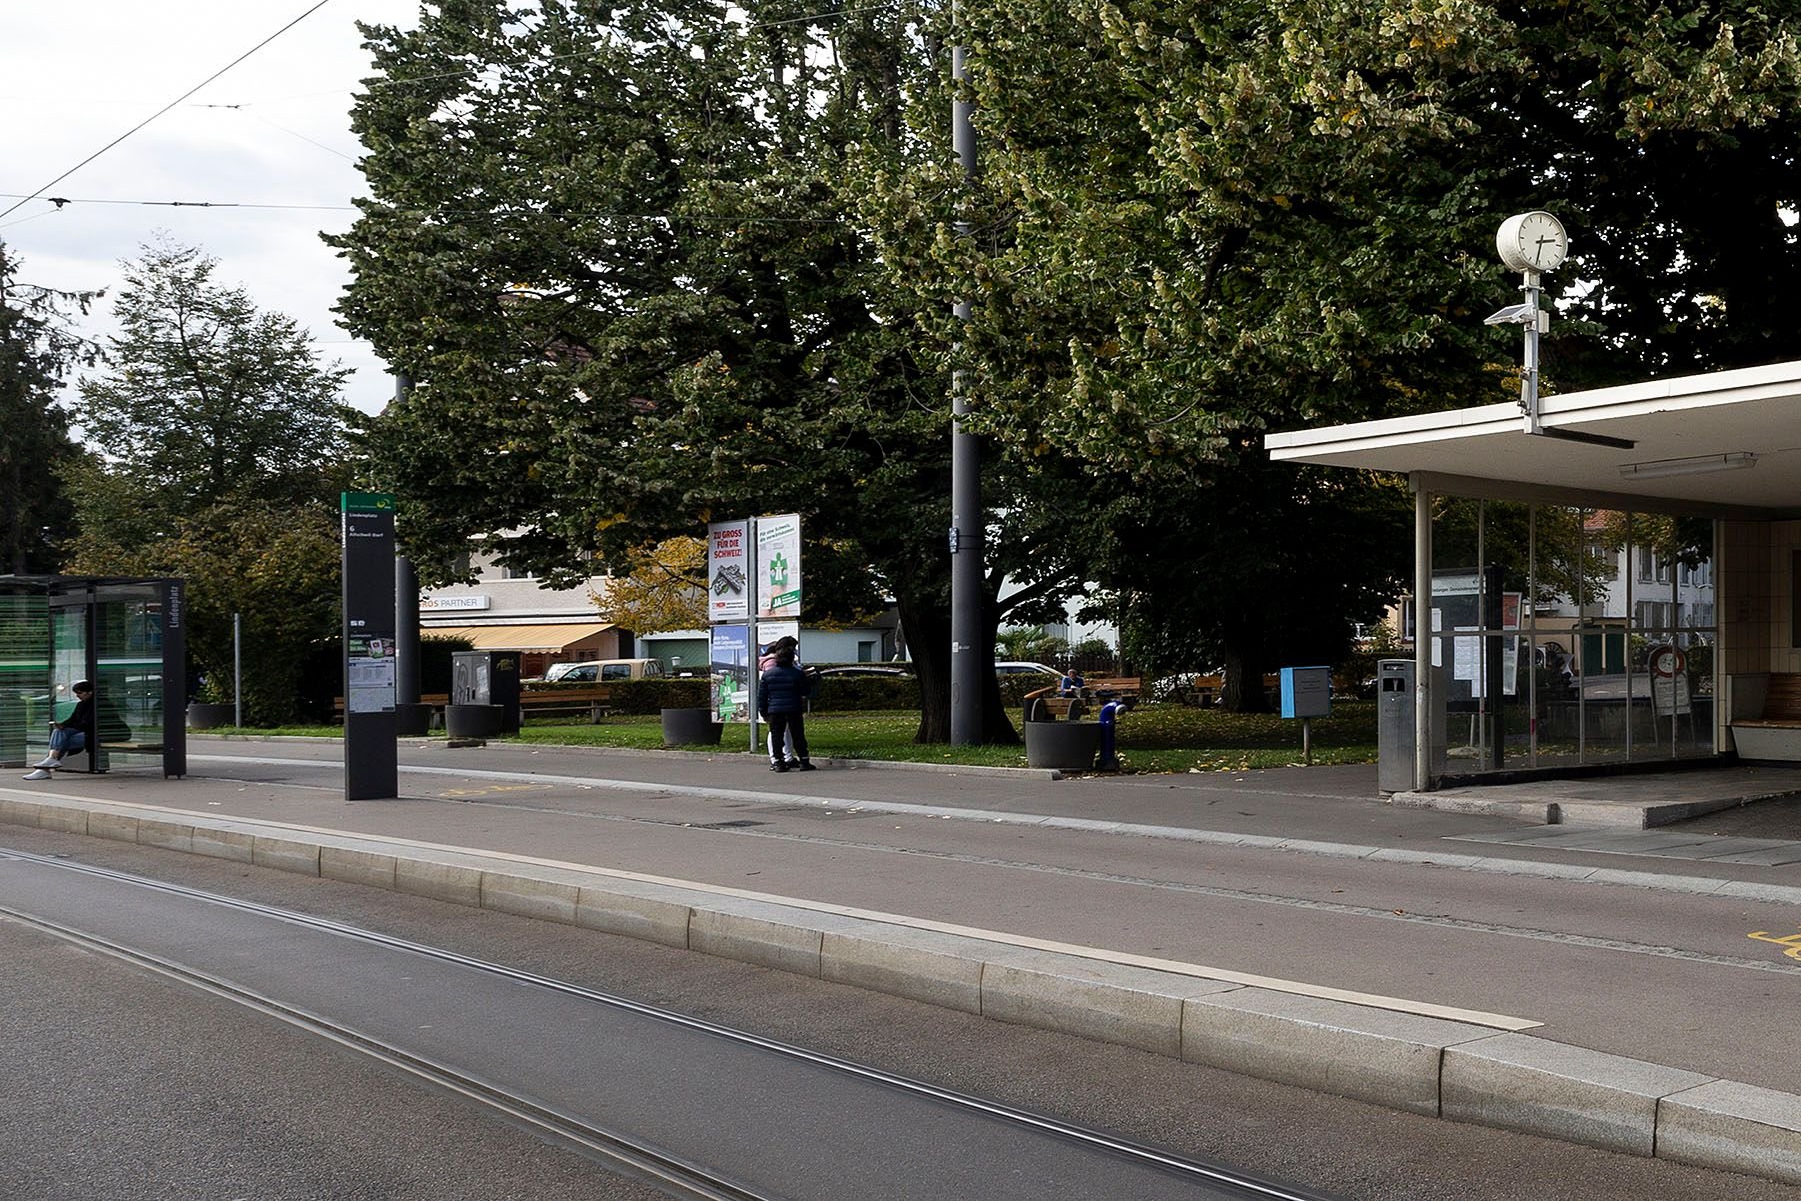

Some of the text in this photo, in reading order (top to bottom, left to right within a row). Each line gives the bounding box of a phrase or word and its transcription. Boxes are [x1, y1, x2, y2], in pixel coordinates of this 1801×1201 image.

[714, 529, 743, 539] ZU GROSS
[717, 539, 739, 549] FÜR DIE
[169, 586, 181, 628] Lindenplatz
[441, 598, 478, 607] PARTNER
